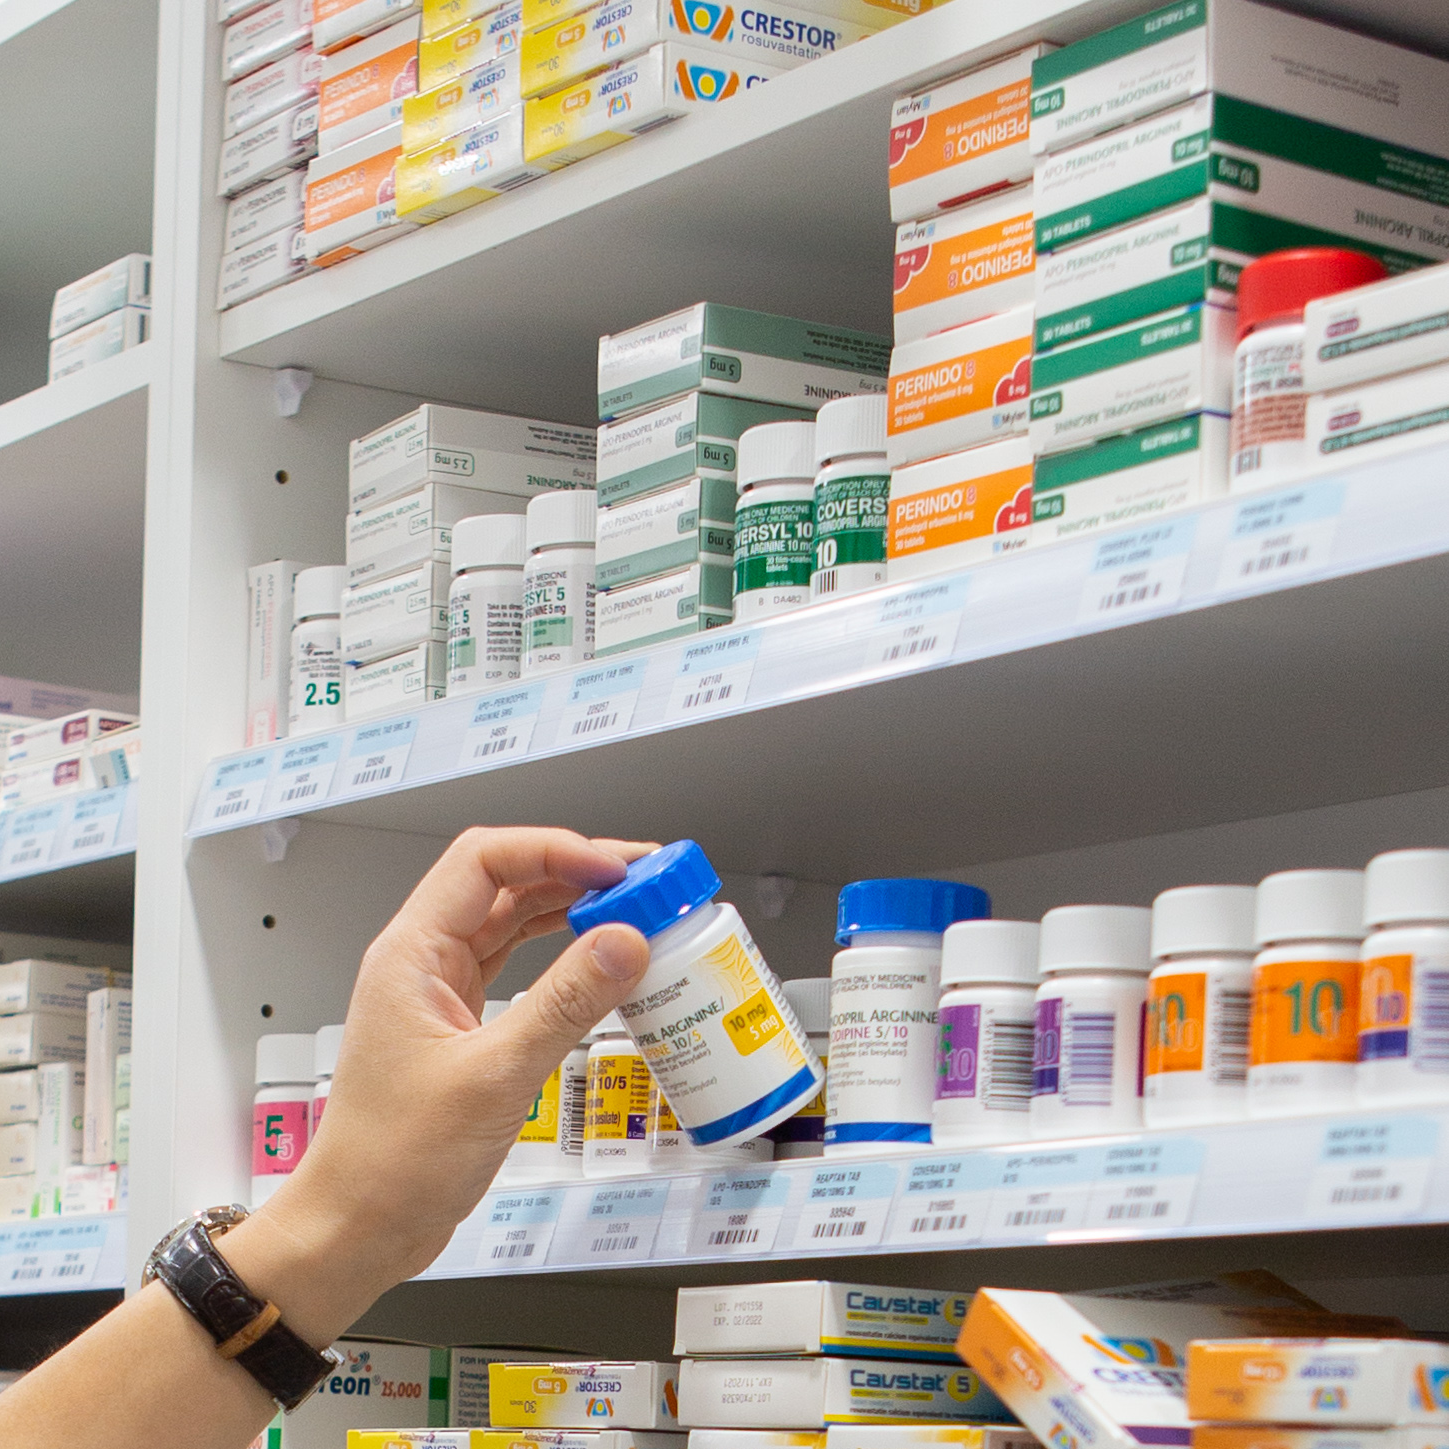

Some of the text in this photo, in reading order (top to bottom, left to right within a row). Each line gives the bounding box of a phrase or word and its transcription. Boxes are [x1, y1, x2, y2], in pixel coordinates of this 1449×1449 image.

[740, 10, 837, 50] CRESTOR
[601, 72, 638, 97] CRESTOR
[957, 116, 1029, 156] PERINDO
[709, 358, 726, 373] mg
[895, 365, 963, 399] PERINDO
[1002, 410, 1027, 424] Mylan
[434, 453, 468, 470] mg 2.5
[527, 474, 576, 489] ARGININE
[750, 503, 810, 522] ONLY MEDICINE
[896, 488, 963, 523] PERINDO
[796, 520, 812, 537] 10
[787, 539, 799, 551] 10
[816, 538, 837, 569] 10
[305, 680, 341, 707] 2.5
[627, 977, 691, 1013] ONLY MEDICINE
[729, 1017, 745, 1032] 10
[760, 1014, 780, 1031] mg
[870, 1010, 938, 1025] ARGININE
[672, 1030, 701, 1051] 10/5
[875, 1026, 908, 1038] 5/10
[947, 1048, 975, 1082] 10
[599, 1076, 627, 1090] 10/5
[846, 1292, 967, 1317] Cavstat 5
[318, 1374, 421, 1399] reon 25,000
[537, 1380, 549, 1392] mg
[850, 1369, 970, 1393] Cavstat 5
[524, 1400, 536, 1413] 30
